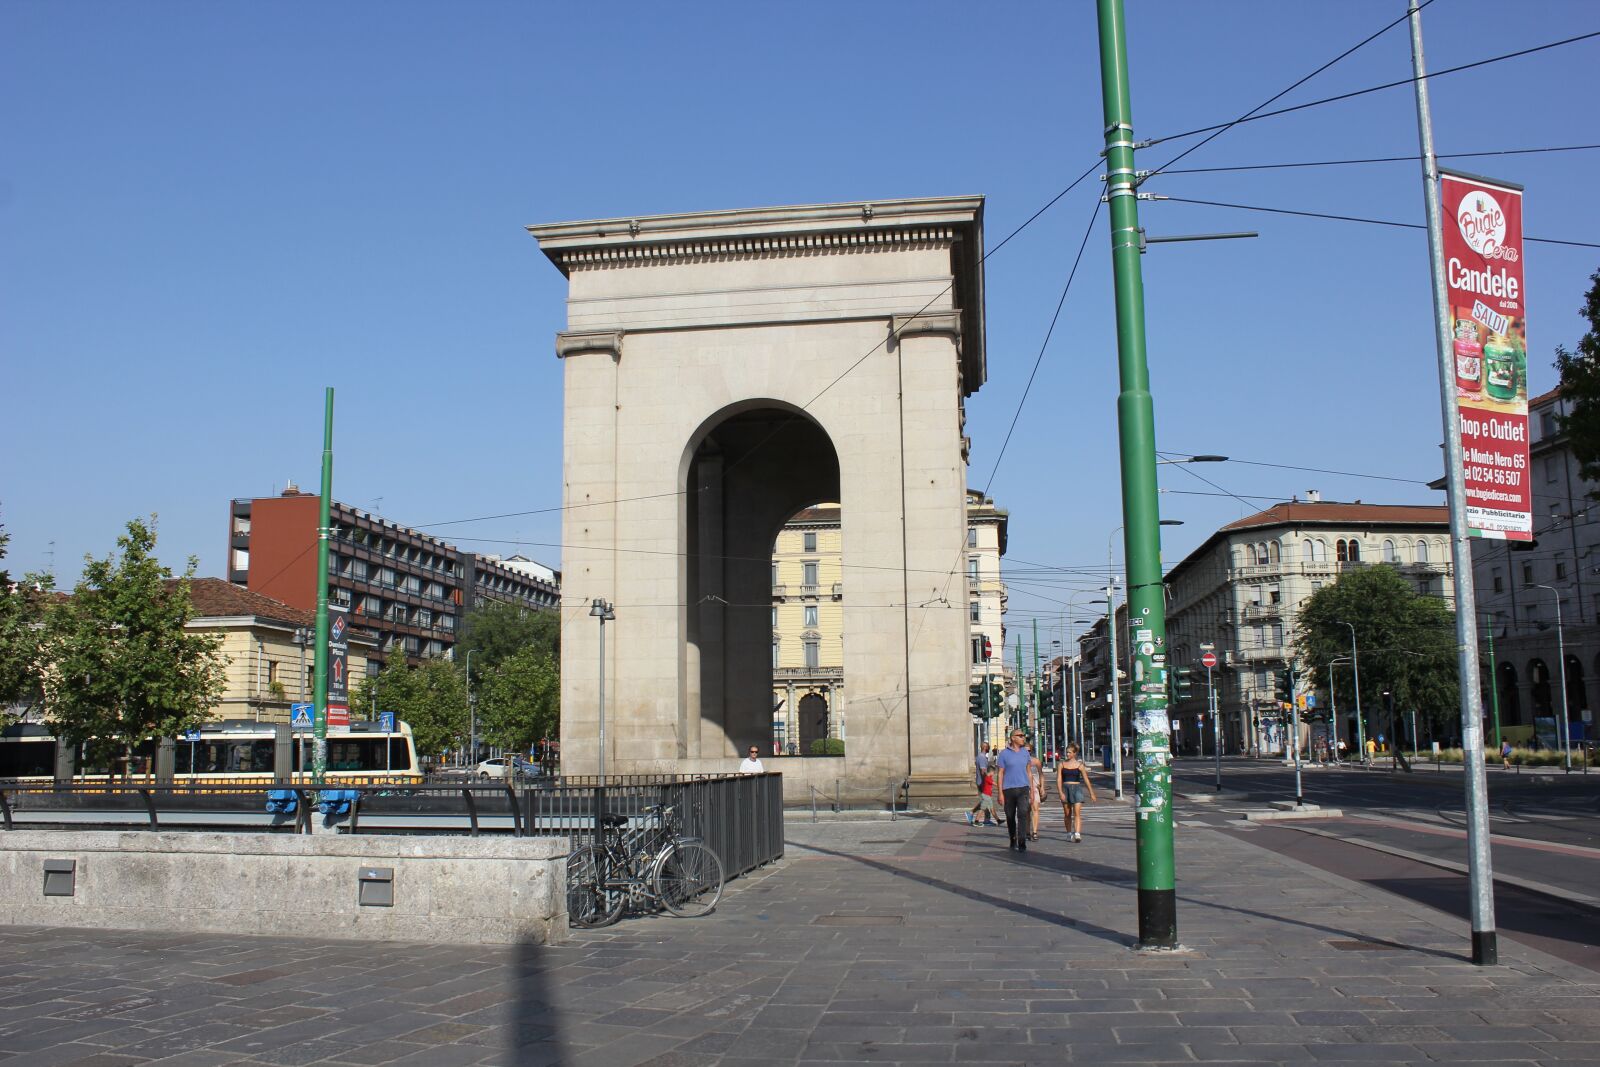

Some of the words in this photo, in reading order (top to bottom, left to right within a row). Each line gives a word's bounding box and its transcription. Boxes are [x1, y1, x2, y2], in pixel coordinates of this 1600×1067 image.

[1460, 208, 1503, 238] Bugie
[1471, 238, 1480, 248] di
[1483, 239, 1518, 262] Cera
[1448, 257, 1518, 299] Candele
[1474, 302, 1506, 335] SALDI
[1460, 413, 1480, 439] hop
[1482, 421, 1489, 437] e
[1490, 418, 1524, 442] Outlet
[1462, 446, 1470, 462] le
[1470, 447, 1494, 465] Monte
[1494, 451, 1512, 467] Nero
[1514, 454, 1525, 468] 65
[1464, 465, 1472, 480] el
[1472, 466, 1483, 482] 02
[1483, 467, 1494, 483] 54
[1494, 469, 1505, 484] 56
[1505, 470, 1520, 486] 507
[1465, 487, 1522, 503] ww.bugiedicera.com
[1481, 508, 1526, 519] Pubblicitario
[1156, 814, 1165, 823] 16
